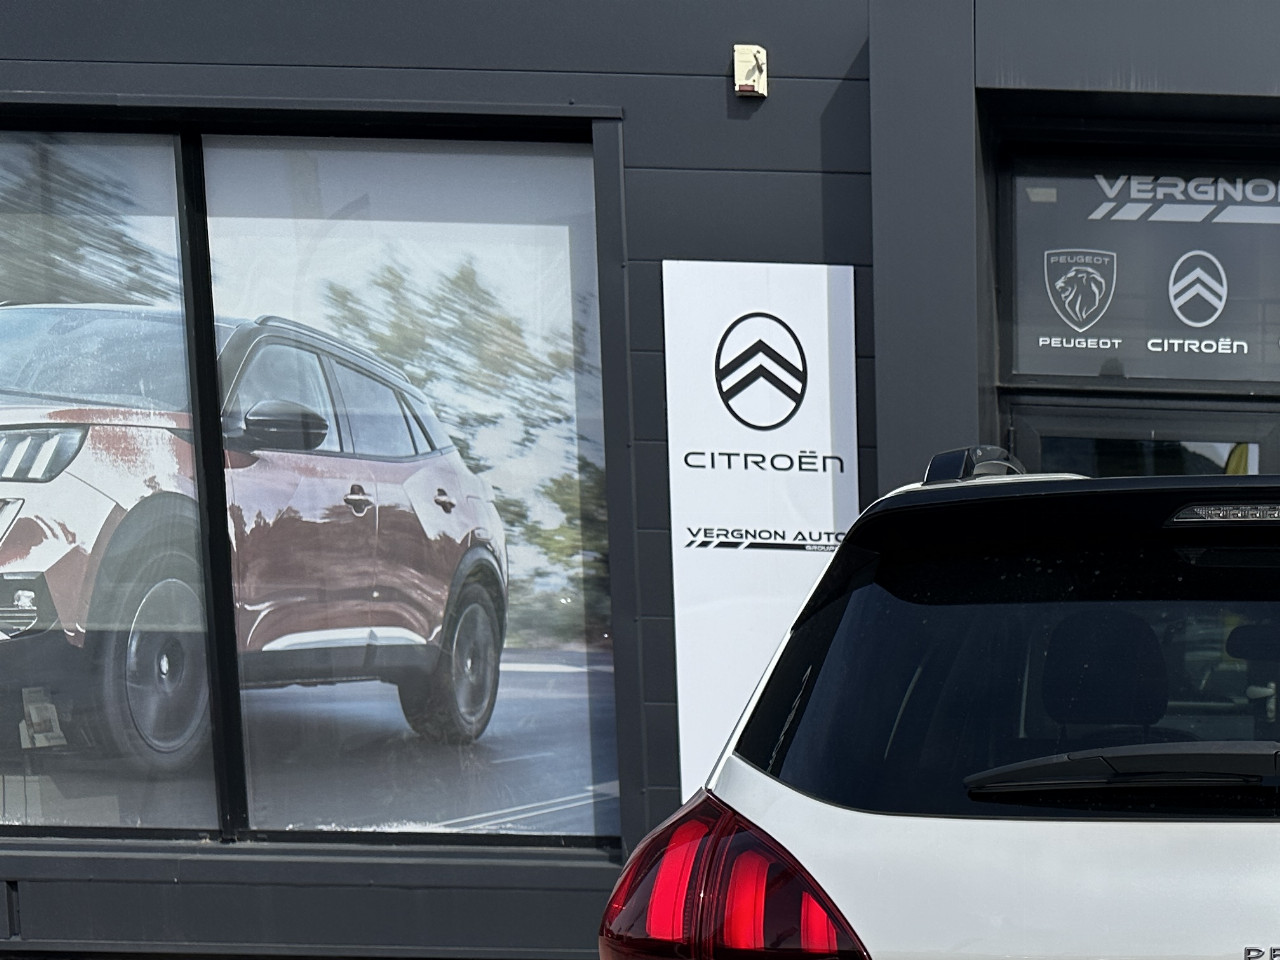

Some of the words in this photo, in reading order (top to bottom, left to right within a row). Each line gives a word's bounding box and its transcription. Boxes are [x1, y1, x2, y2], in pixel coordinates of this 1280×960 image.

[1050, 256, 1110, 266] PEUGEOT
[1038, 337, 1122, 349] PEUGEOT
[687, 527, 786, 541] VERGNON
